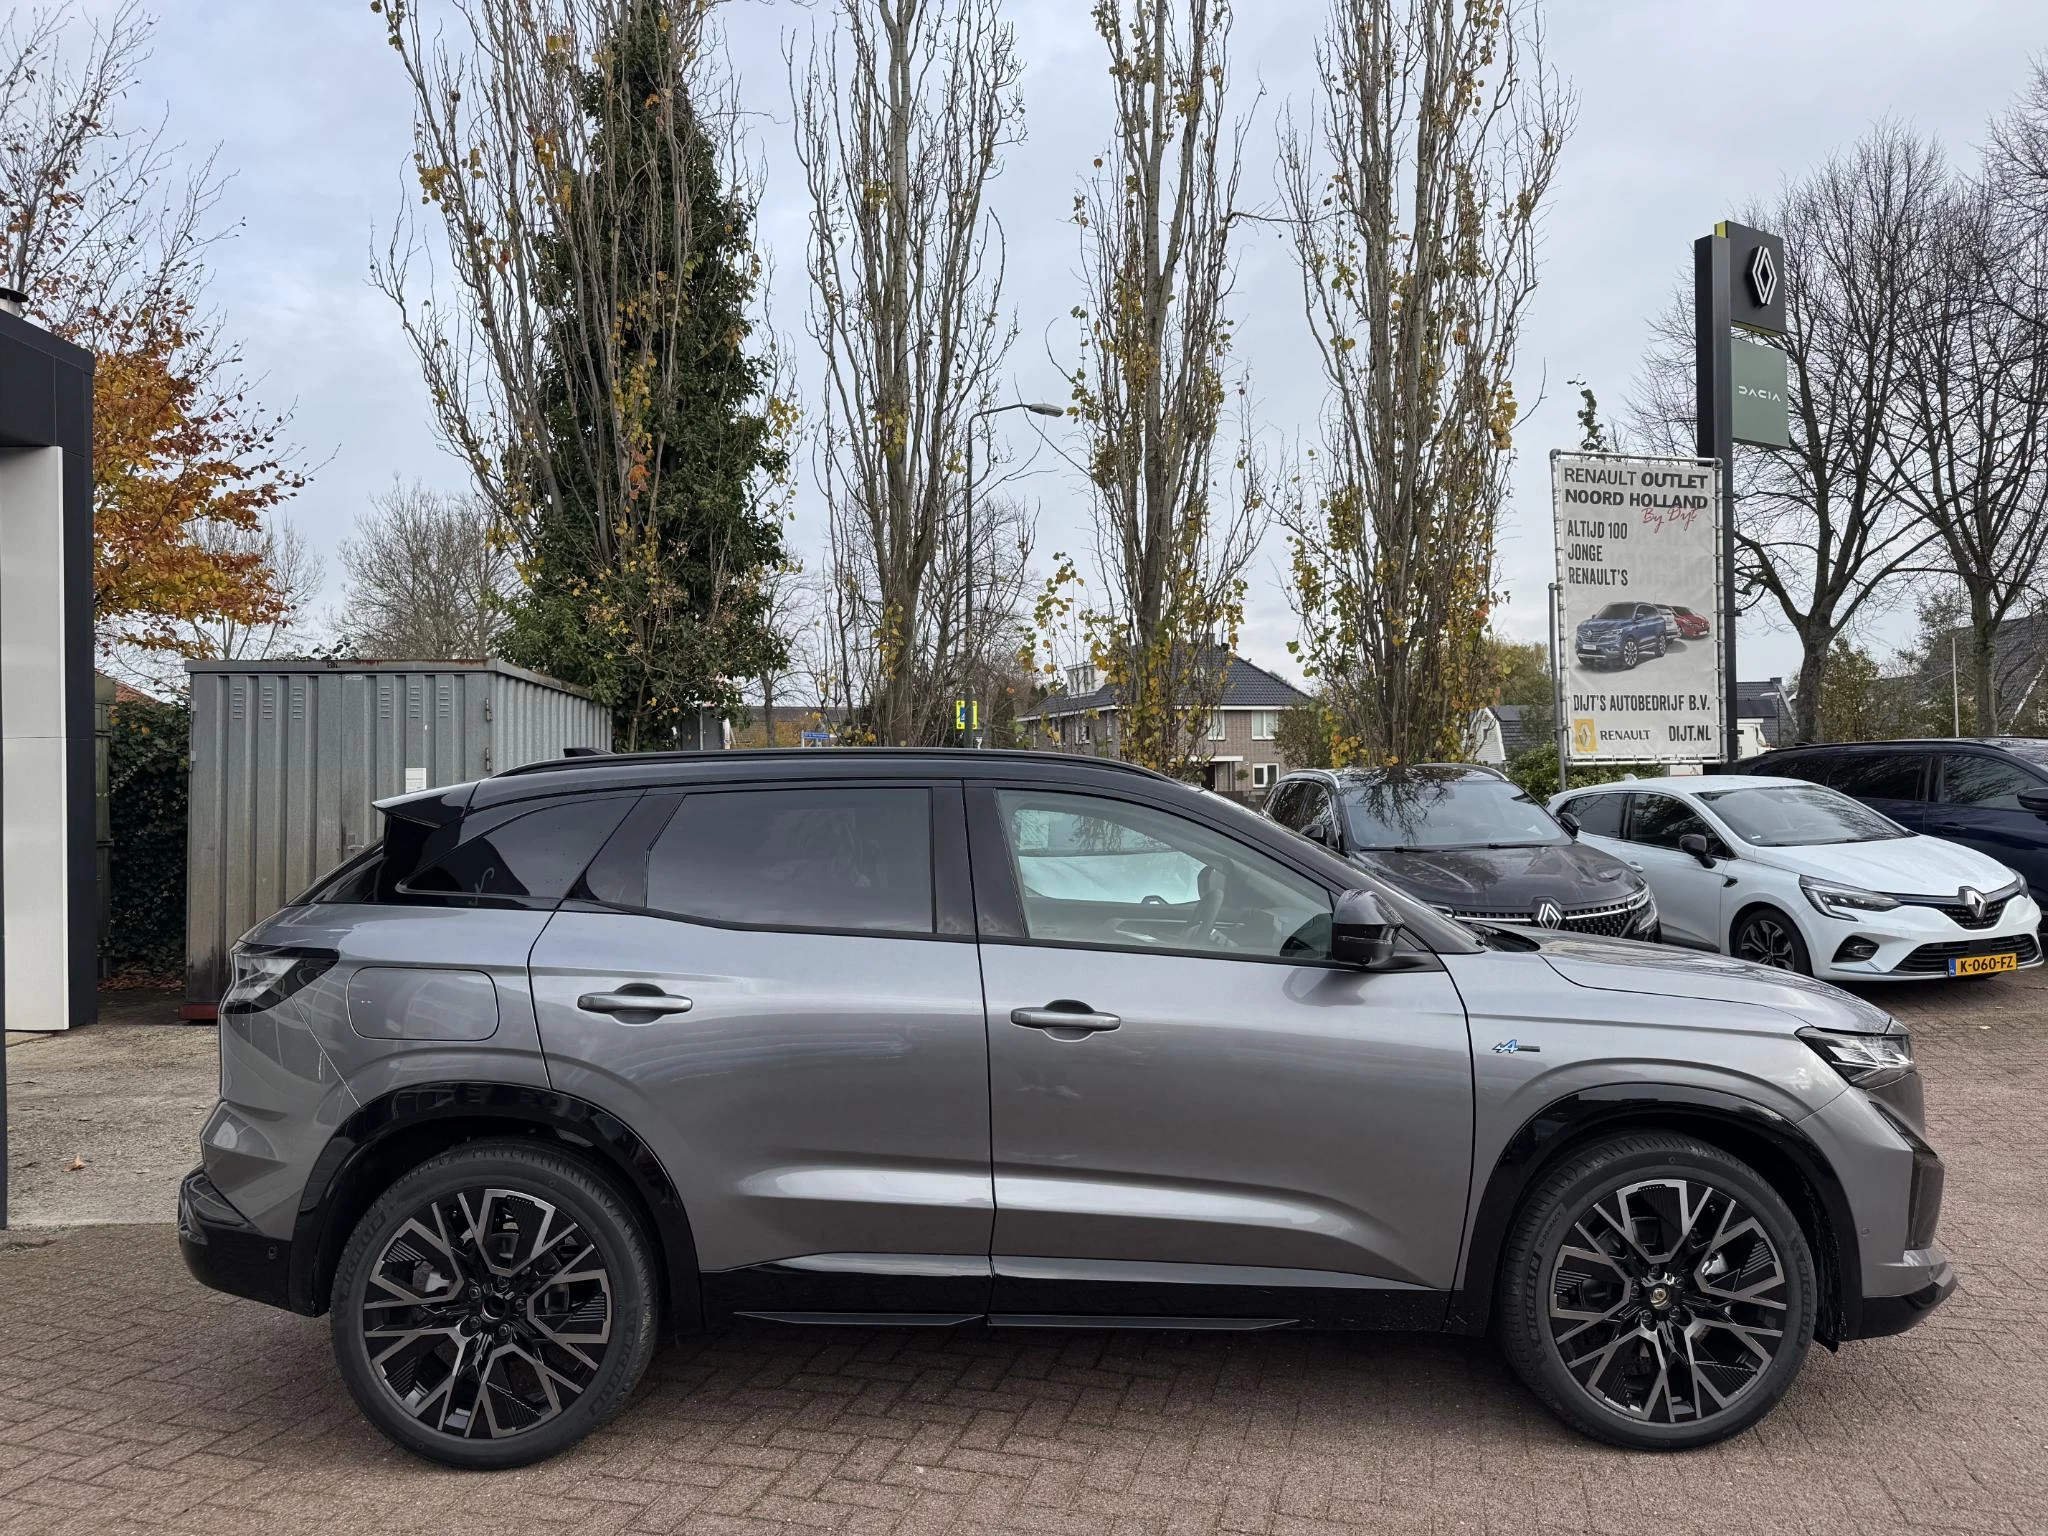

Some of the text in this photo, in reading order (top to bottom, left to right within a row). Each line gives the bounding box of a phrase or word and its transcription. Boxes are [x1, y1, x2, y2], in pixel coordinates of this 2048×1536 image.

[1738, 385, 1781, 402] DACIA
[1564, 467, 1709, 489] RENAULT OUTLET
[1565, 488, 1709, 510] NOORD HOLLAND
[1567, 519, 1628, 540] ALTIJD 100
[1567, 543, 1604, 562] JONGE
[1568, 566, 1629, 587] RENAULT'S
[1573, 694, 1711, 712] DIJT'S AUTOBEDRIJF B.V.
[1600, 729, 1651, 741] RENAULT
[1668, 724, 1712, 742] DIJT.NL
[1960, 955, 2014, 973] K-060-FZ
